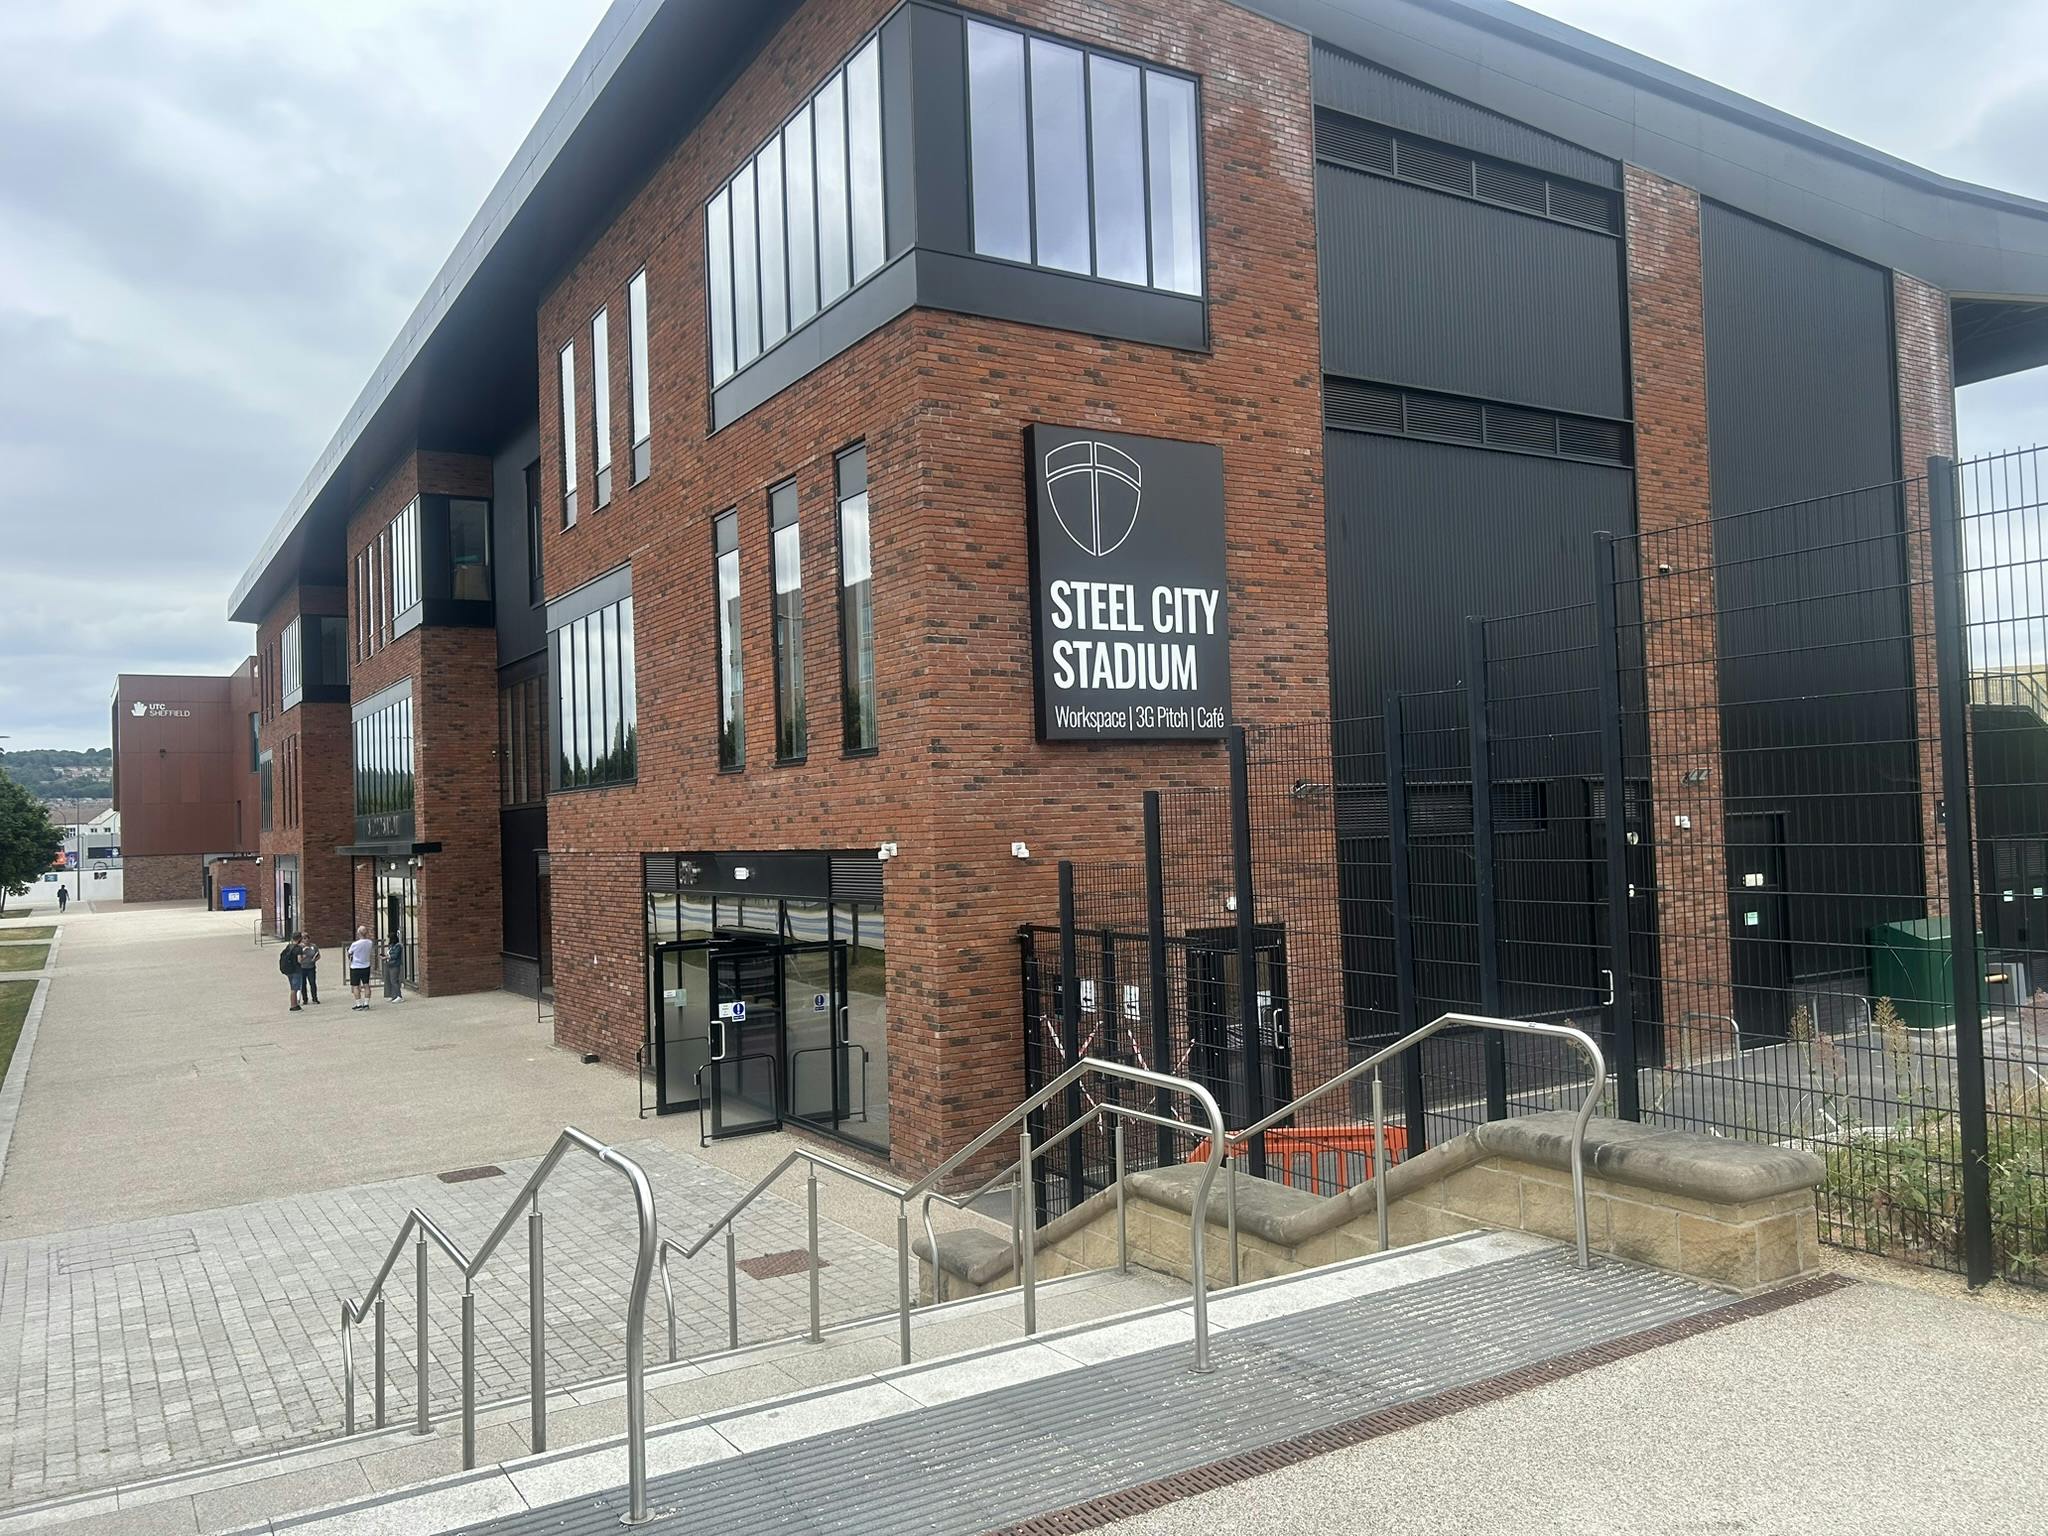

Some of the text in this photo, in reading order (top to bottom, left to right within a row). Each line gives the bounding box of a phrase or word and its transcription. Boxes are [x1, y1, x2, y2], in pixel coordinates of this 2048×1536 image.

[1050, 580, 1219, 635] STEEL CITY
[1052, 640, 1198, 691] STADIUM
[1054, 705, 1127, 733] Workspace
[1135, 705, 1154, 728] 3G
[1157, 706, 1189, 728] Pitch
[1197, 706, 1225, 729] Café
